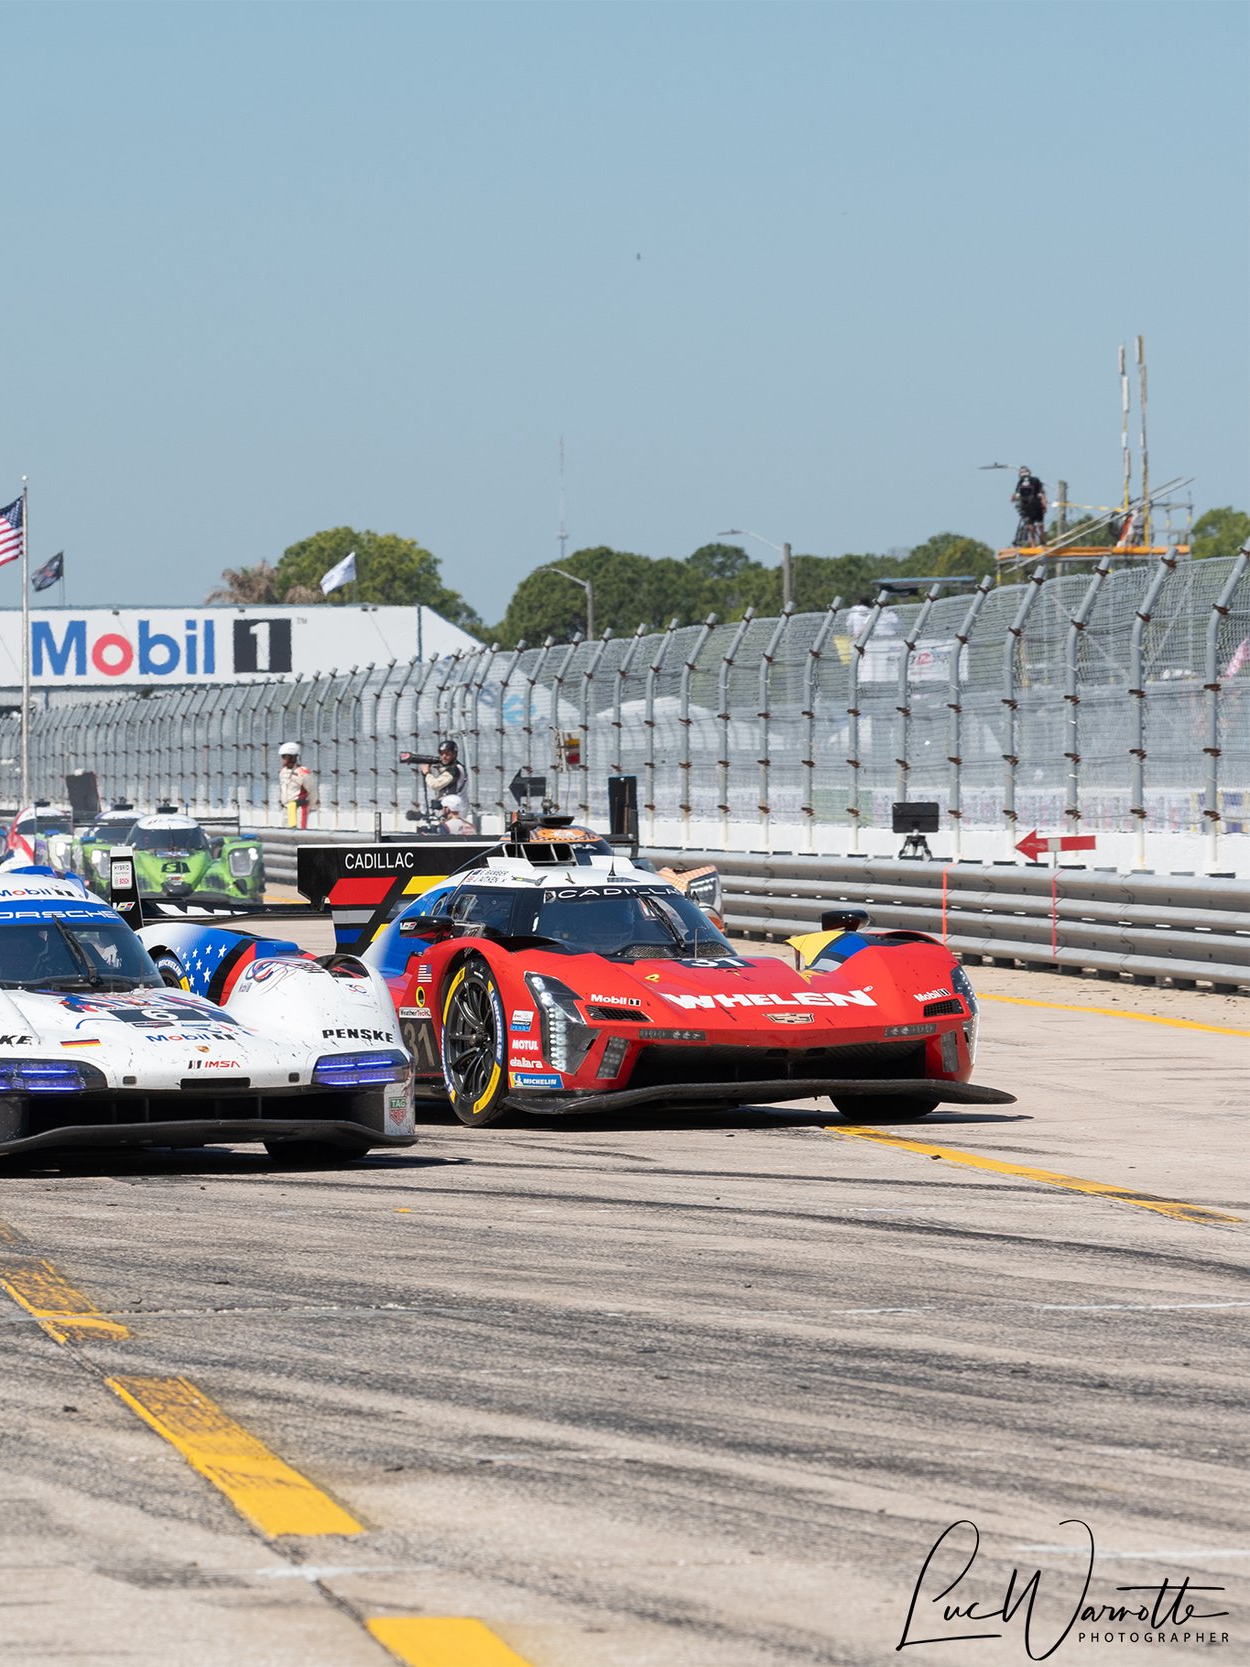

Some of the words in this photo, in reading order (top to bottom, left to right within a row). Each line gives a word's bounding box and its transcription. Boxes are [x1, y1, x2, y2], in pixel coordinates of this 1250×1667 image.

[31, 619, 215, 677] Mobil
[344, 852, 414, 870] CADILLAC
[690, 957, 746, 968] 31
[590, 993, 627, 1006] Mobil
[659, 989, 878, 1010] WHELEN
[141, 1008, 179, 1021] 6
[145, 1033, 211, 1042] Mobil
[322, 1028, 395, 1044] PENSKE
[404, 1022, 436, 1067] 31
[511, 1039, 539, 1051] MOTUL
[204, 1060, 241, 1068] IMSA
[523, 1077, 557, 1086] MICHELIN
